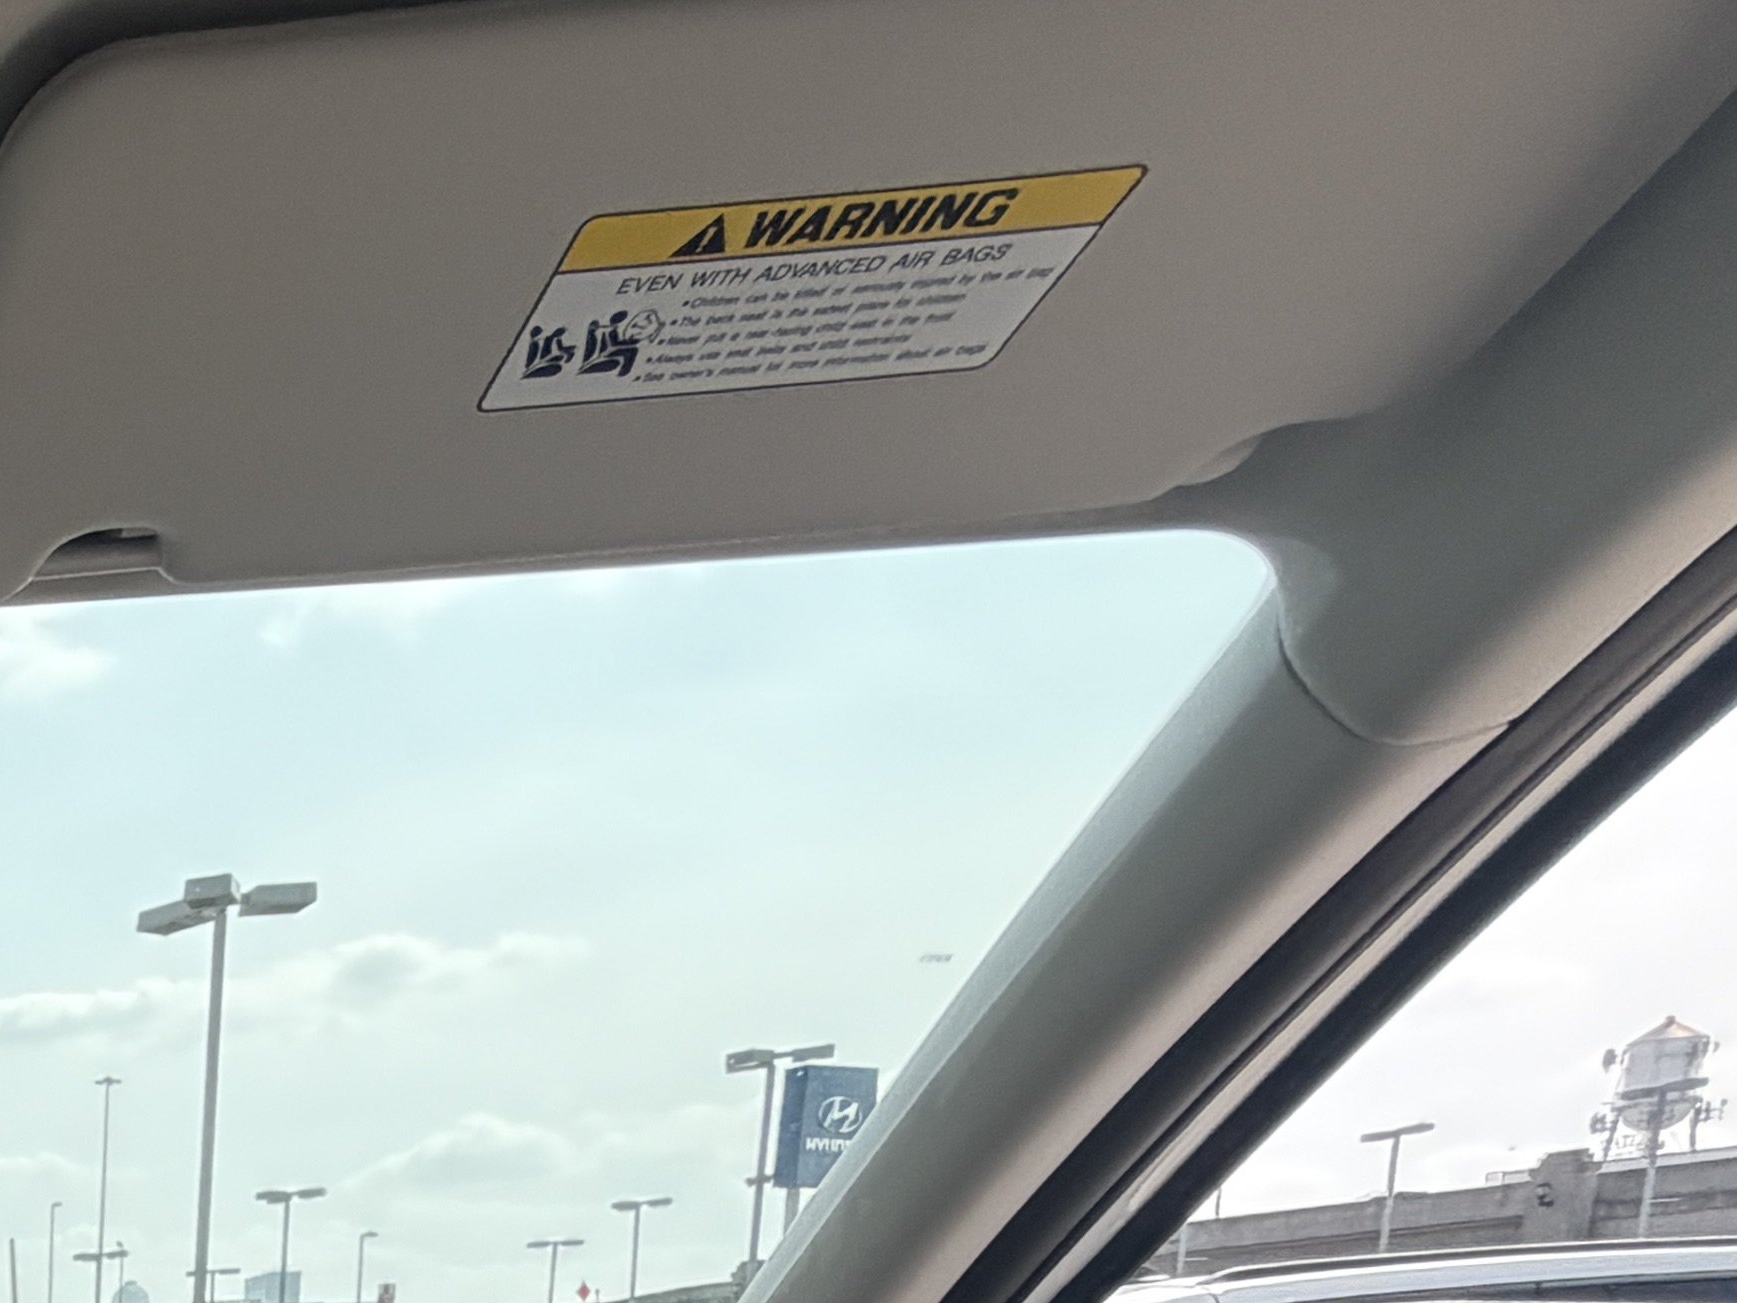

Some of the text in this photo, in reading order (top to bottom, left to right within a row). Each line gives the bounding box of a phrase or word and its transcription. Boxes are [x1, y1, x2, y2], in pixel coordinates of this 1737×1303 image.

[743, 187, 1020, 249] WARNING
[616, 243, 1010, 295] EVEN WITH ADVANCED AIR BAGS
